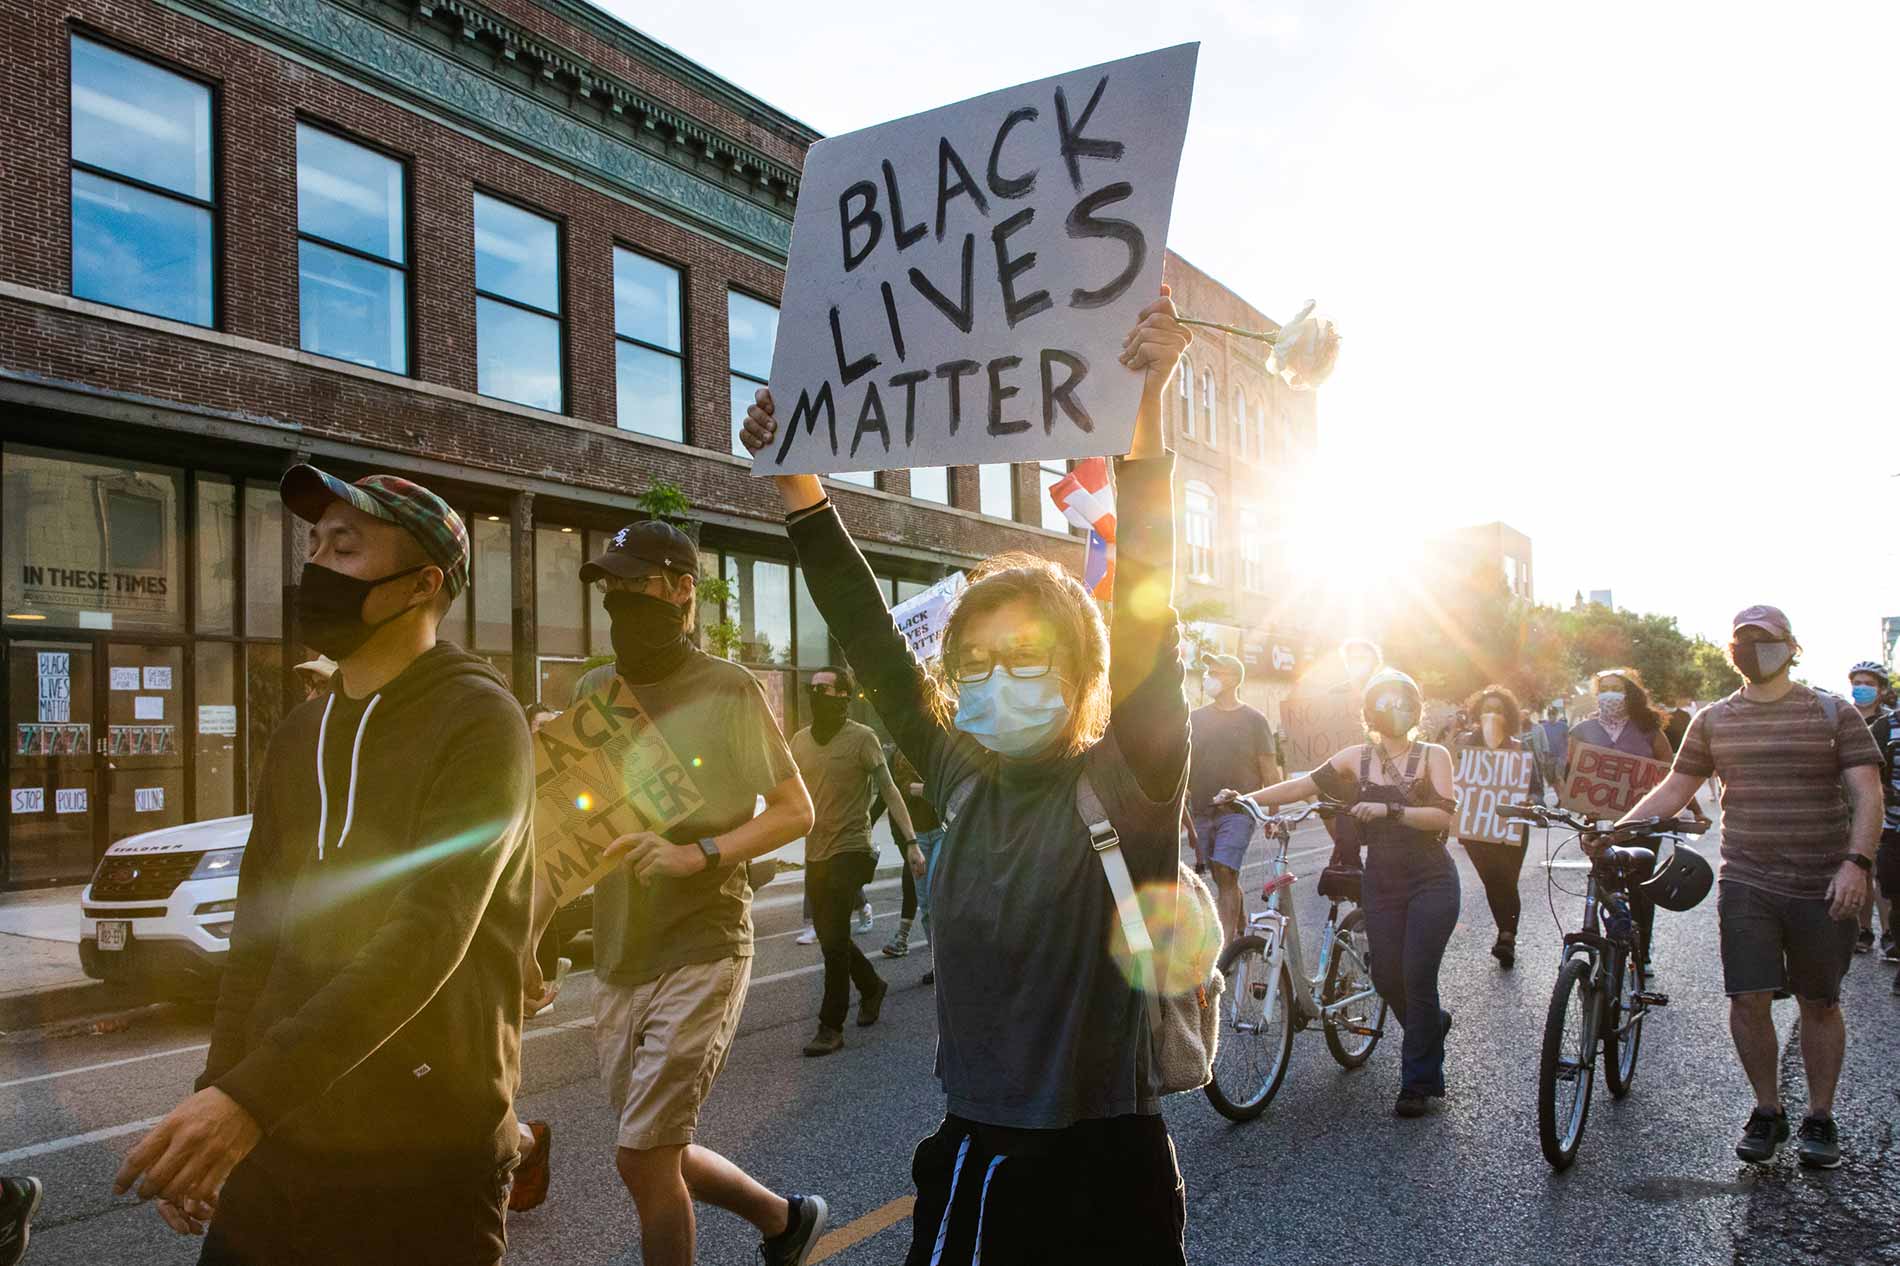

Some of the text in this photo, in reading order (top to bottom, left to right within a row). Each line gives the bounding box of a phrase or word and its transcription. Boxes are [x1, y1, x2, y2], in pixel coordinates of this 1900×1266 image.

[838, 75, 1125, 273] BLACK
[829, 181, 1147, 386] LIVES
[775, 348, 1095, 464] MATTER
[23, 565, 167, 594] IN THESE TIMES
[897, 610, 928, 631] LACK
[913, 630, 942, 650] ATTE
[41, 655, 70, 674] BLACK
[41, 678, 70, 699] LIVES
[536, 679, 640, 789] ACK
[1454, 749, 1534, 789] JUSTICE
[1577, 749, 1672, 790] DEFUN
[15, 790, 42, 811] STOP
[58, 791, 86, 810] POLICE
[544, 765, 703, 898] MATTER
